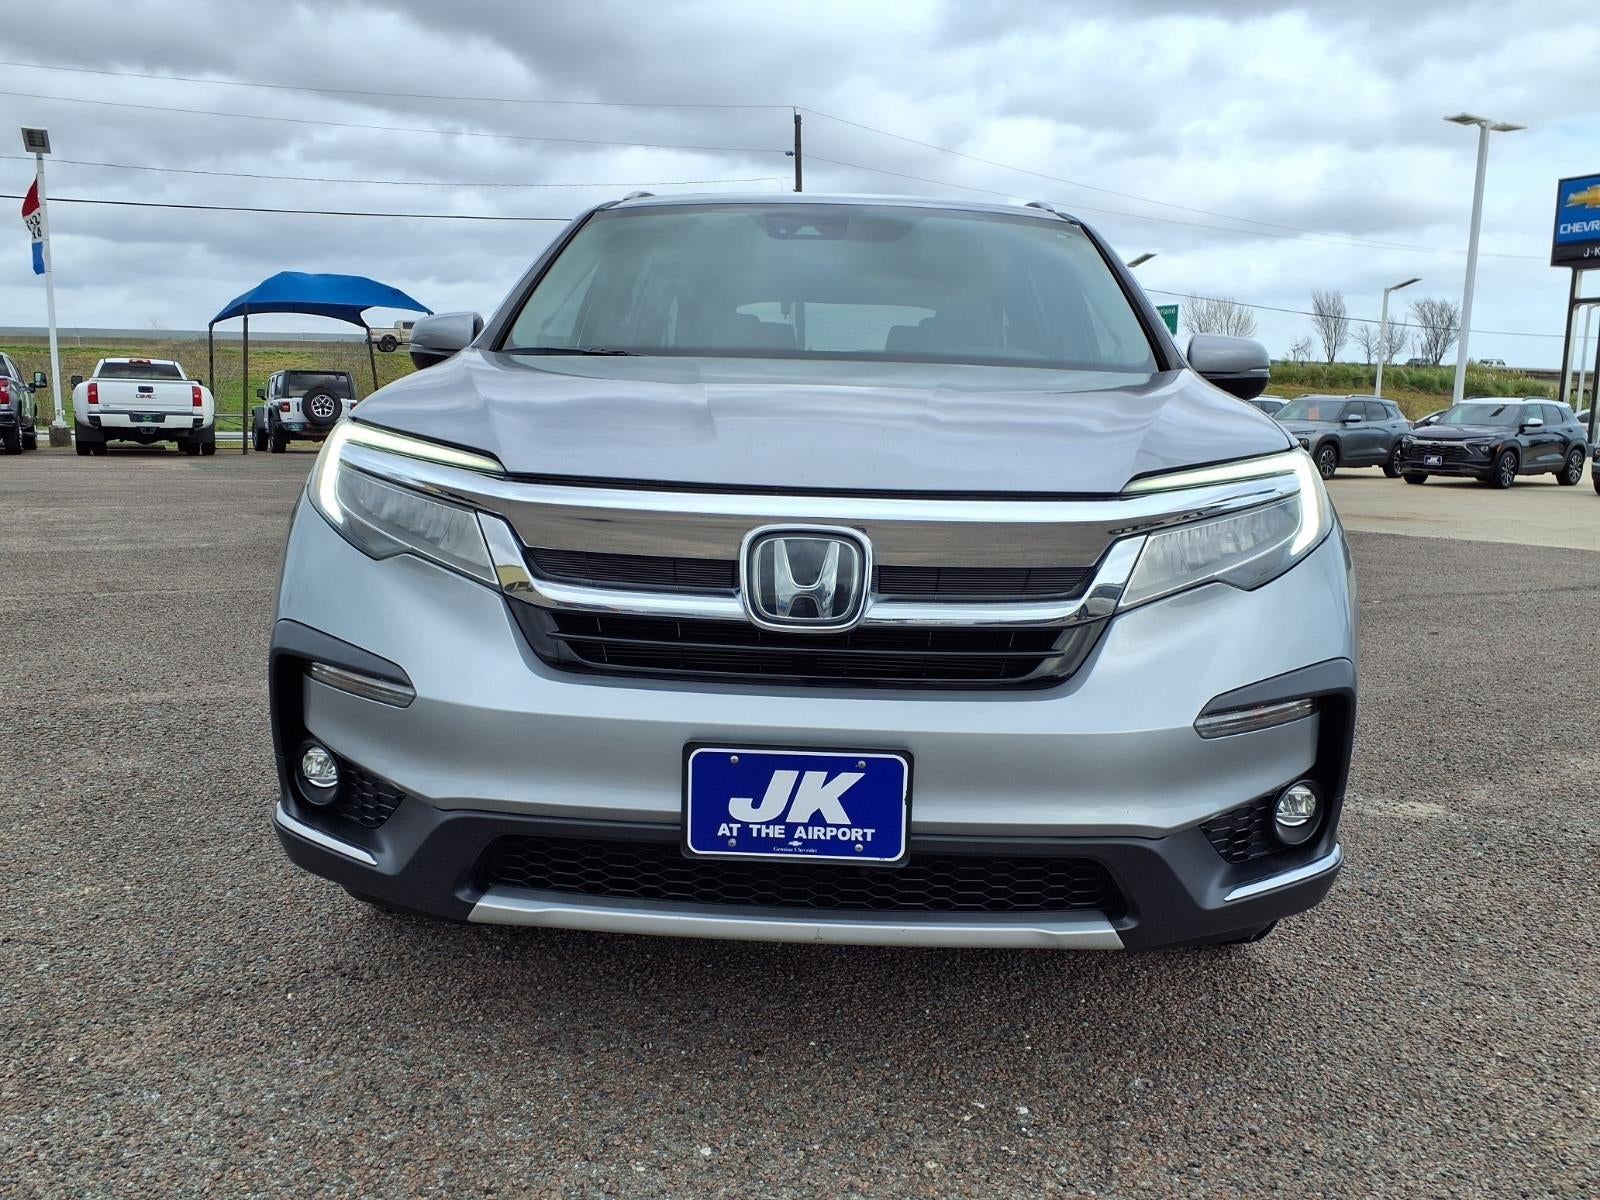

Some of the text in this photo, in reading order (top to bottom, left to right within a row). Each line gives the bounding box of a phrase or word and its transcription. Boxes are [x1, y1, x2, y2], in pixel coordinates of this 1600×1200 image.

[728, 770, 866, 825] JK
[717, 823, 876, 842] AT THE AIRPORT
